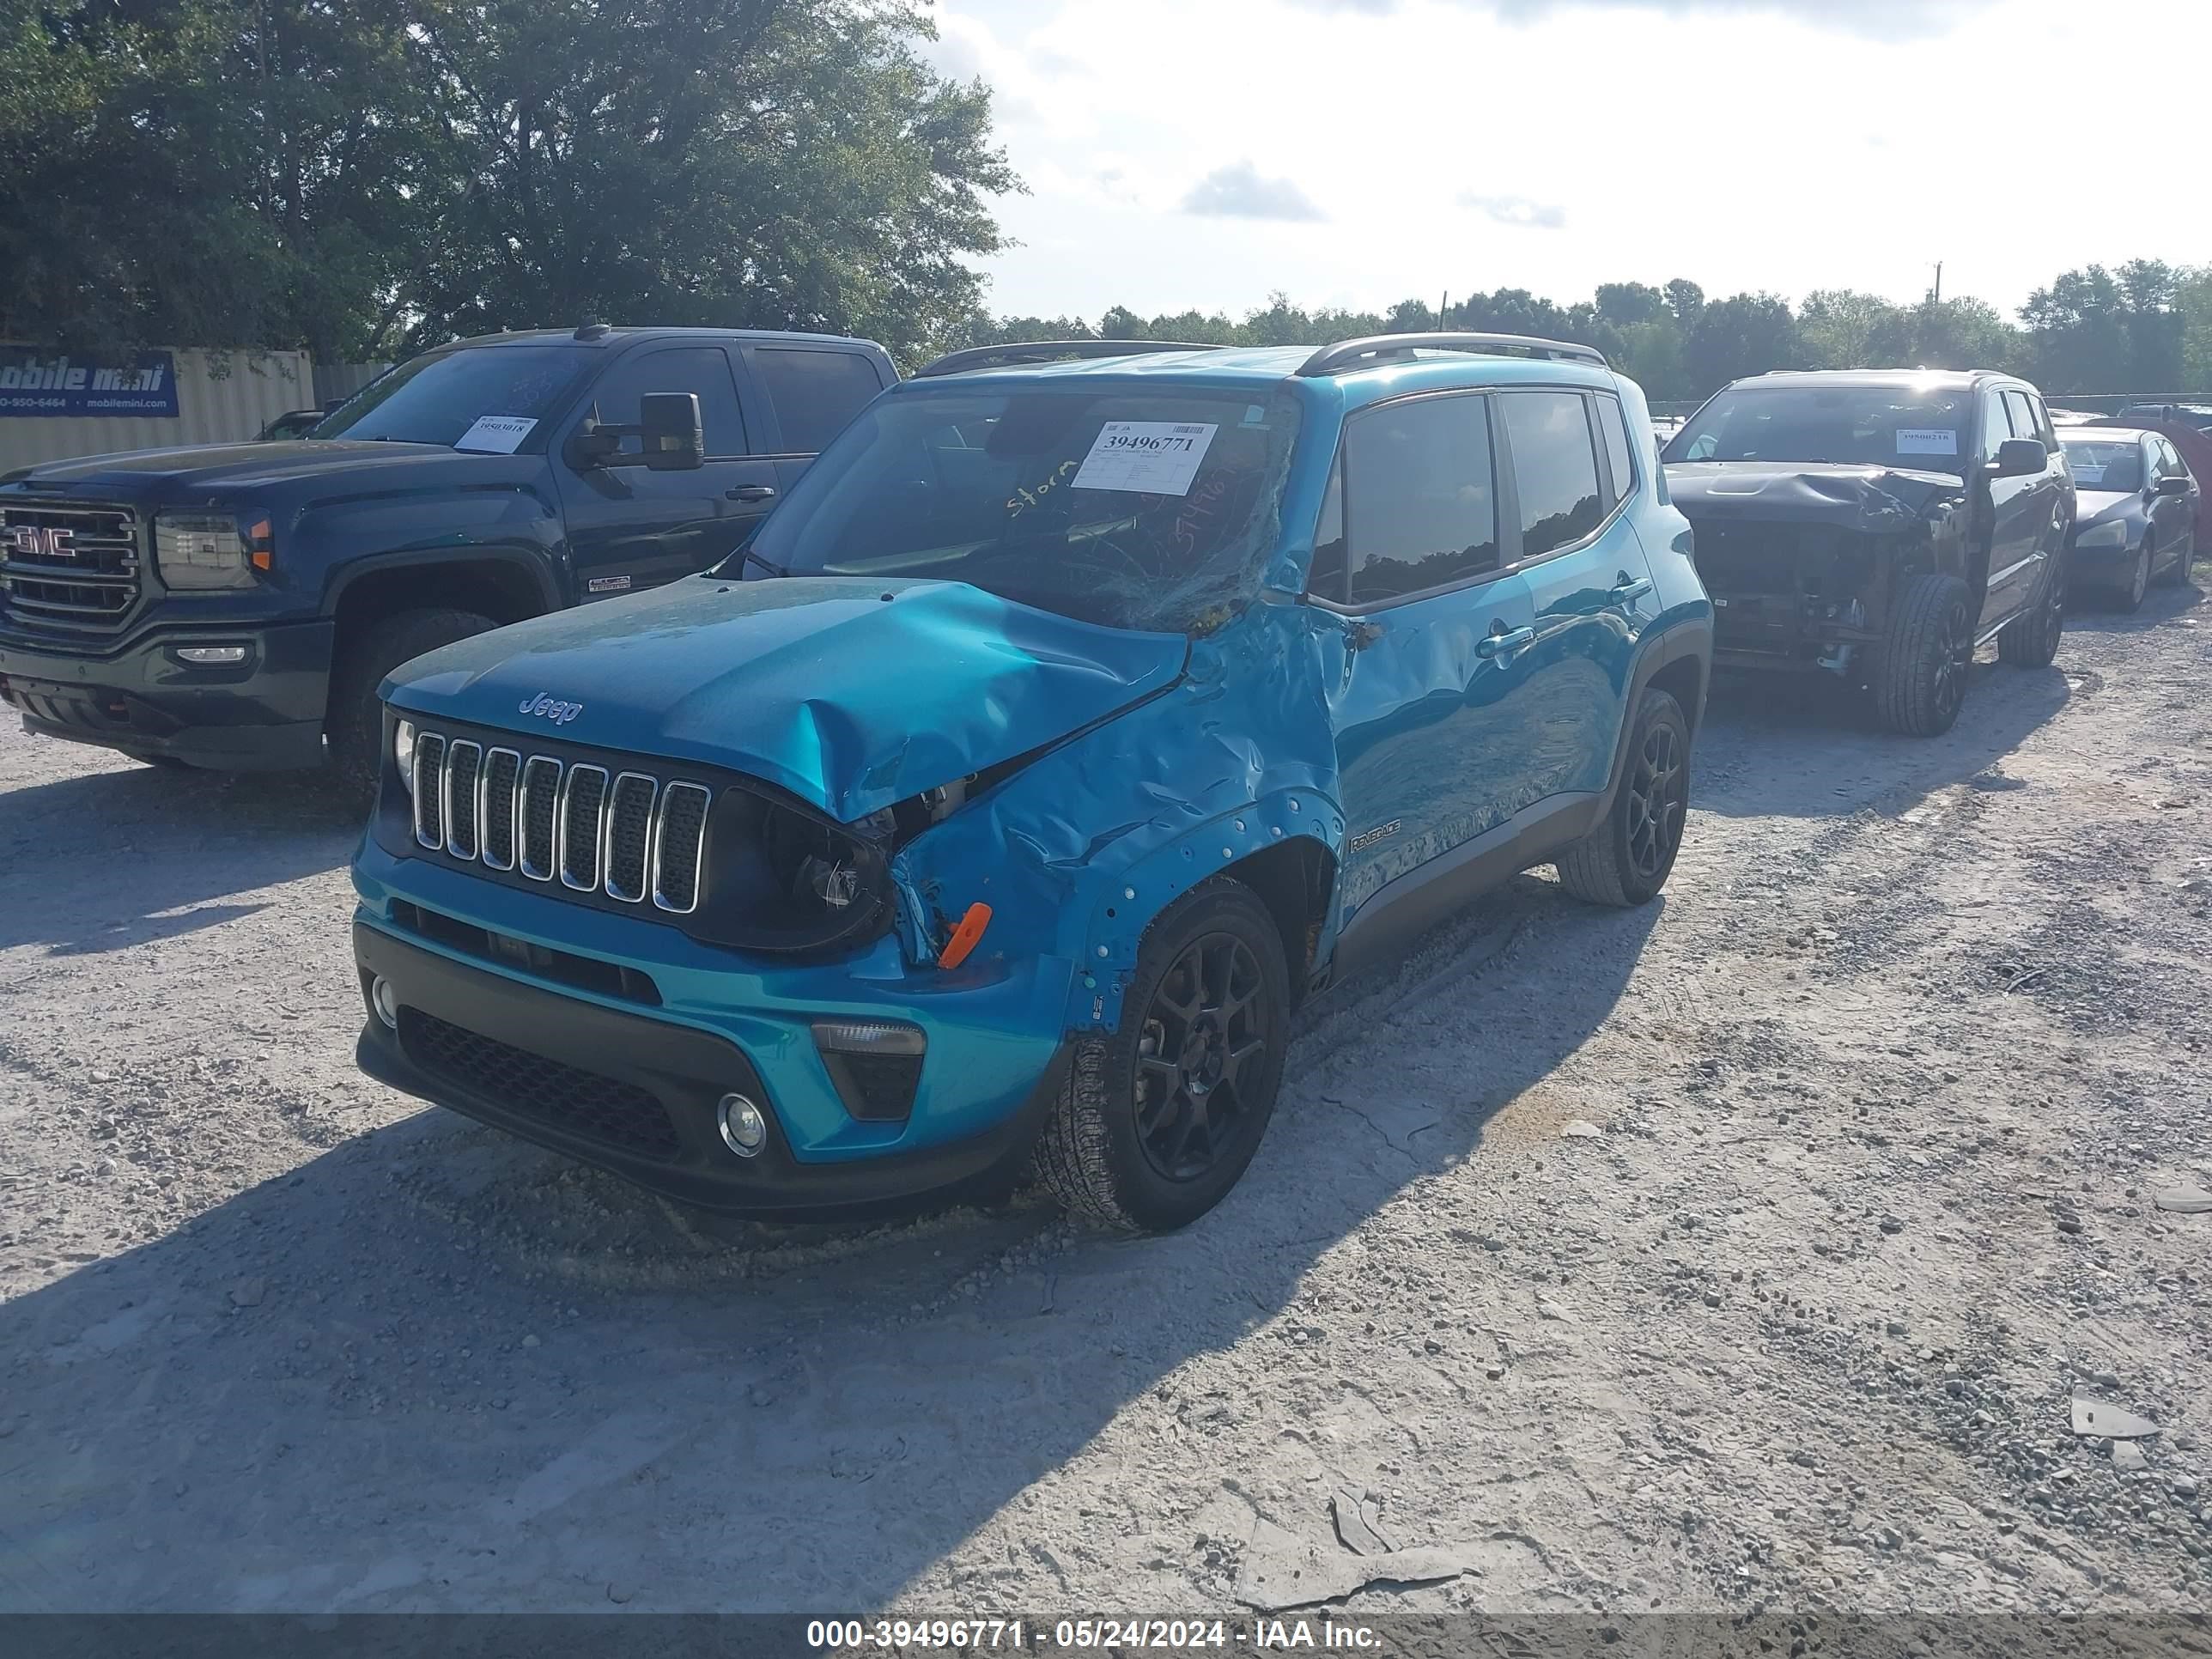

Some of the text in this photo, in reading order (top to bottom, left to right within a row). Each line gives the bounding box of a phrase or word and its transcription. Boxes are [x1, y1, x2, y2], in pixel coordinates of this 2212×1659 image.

[88, 398, 167, 409] mobilemini.com
[1103, 435, 1195, 452] 39496771
[14, 525, 76, 556] GMC
[518, 691, 583, 726] Jeep
[1350, 819, 1401, 854] RENEGADE
